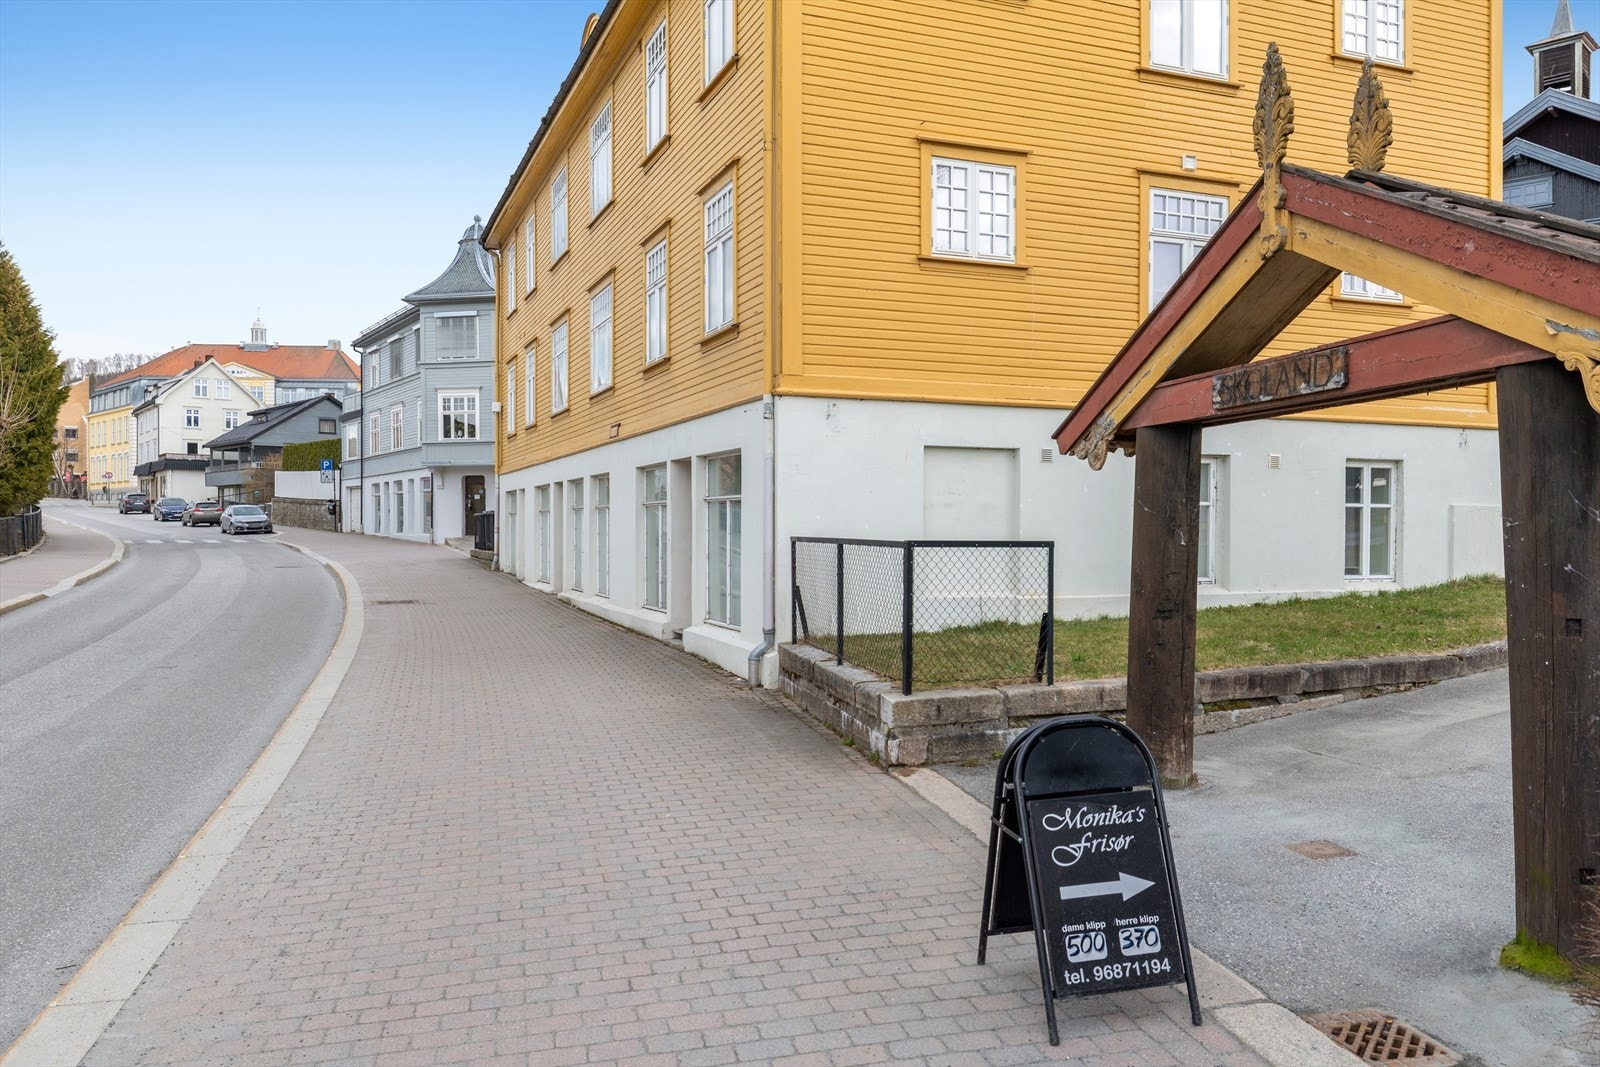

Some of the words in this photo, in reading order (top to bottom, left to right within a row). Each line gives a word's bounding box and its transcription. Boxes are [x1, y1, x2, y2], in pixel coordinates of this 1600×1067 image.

[1217, 354, 1333, 405] SKOLAND
[323, 461, 330, 469] P
[1042, 805, 1146, 831] Monika's
[1051, 832, 1135, 867] Frisør
[1061, 924, 1085, 933] dame
[1086, 921, 1106, 931] klipp
[1115, 917, 1138, 926] herre
[1139, 914, 1160, 925] klipp
[1067, 932, 1105, 957] 500
[1120, 927, 1159, 950] 370
[1063, 968, 1090, 985] tel.
[1093, 957, 1171, 982] 96871194
